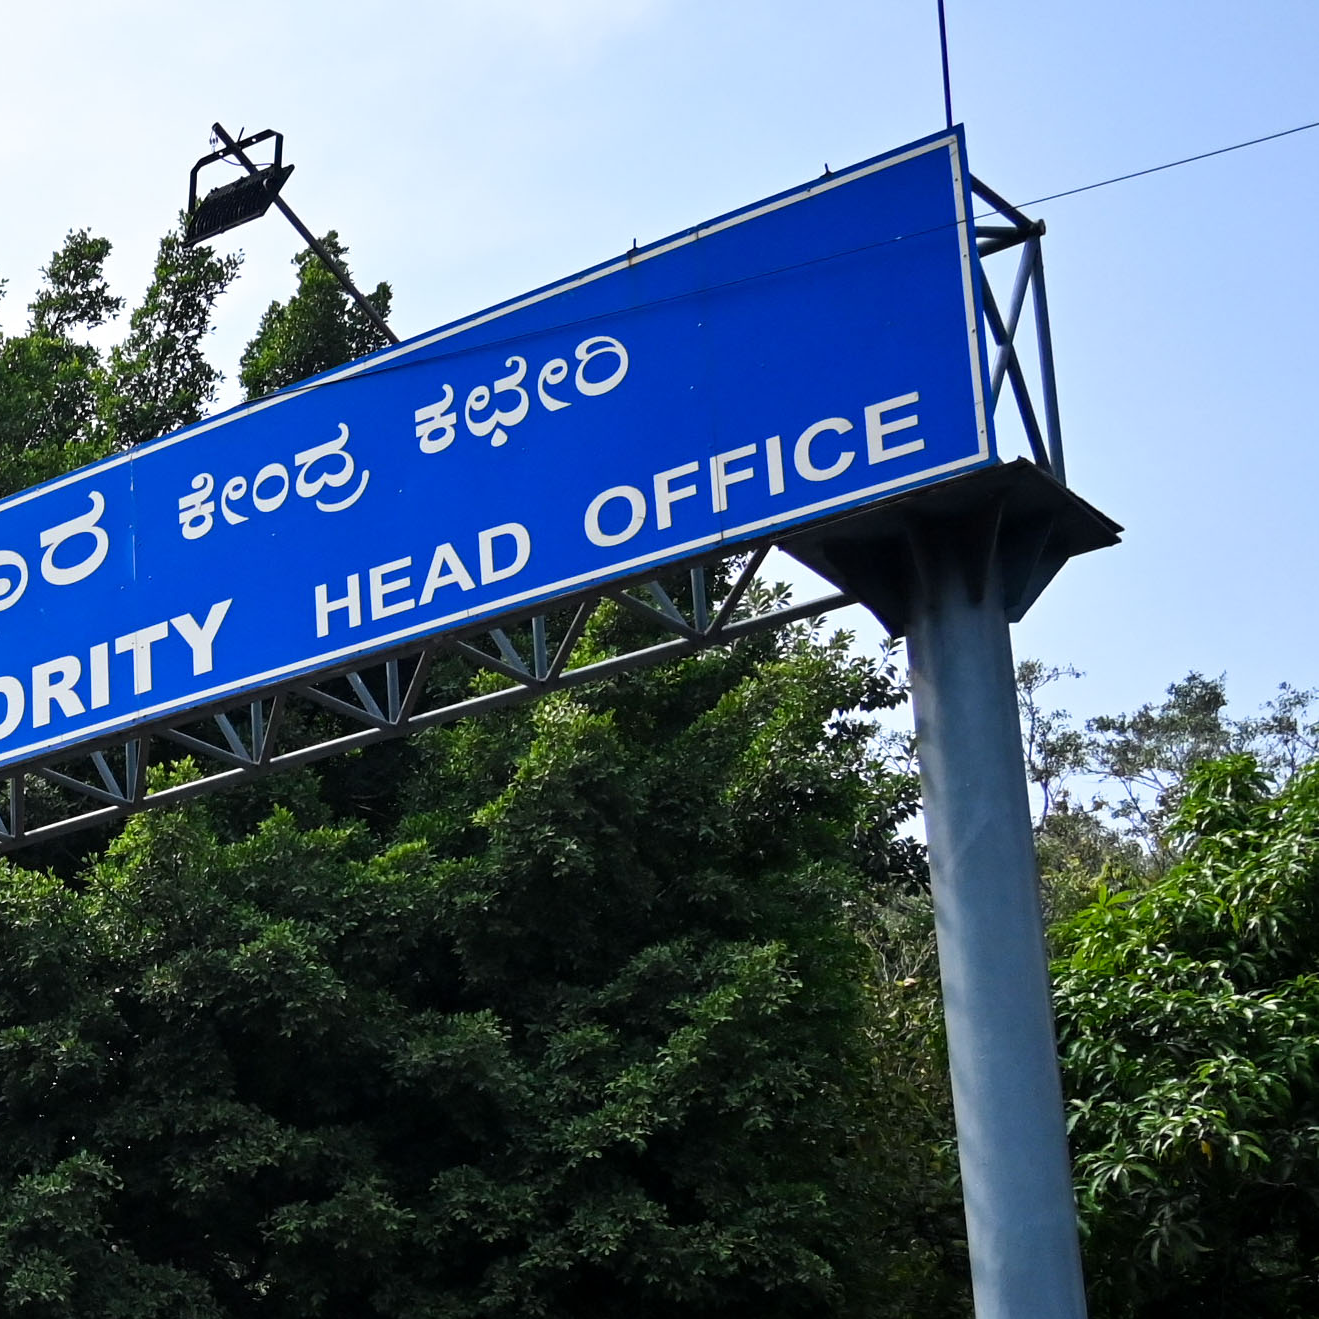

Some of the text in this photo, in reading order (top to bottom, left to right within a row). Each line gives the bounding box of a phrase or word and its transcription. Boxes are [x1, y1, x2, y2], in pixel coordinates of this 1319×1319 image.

[177, 421, 371, 540] ಕೇಂದ್ರ
[413, 334, 630, 456] ಕಛೇರಿ
[314, 522, 532, 638] HEAD
[584, 390, 926, 548] OFFICE
